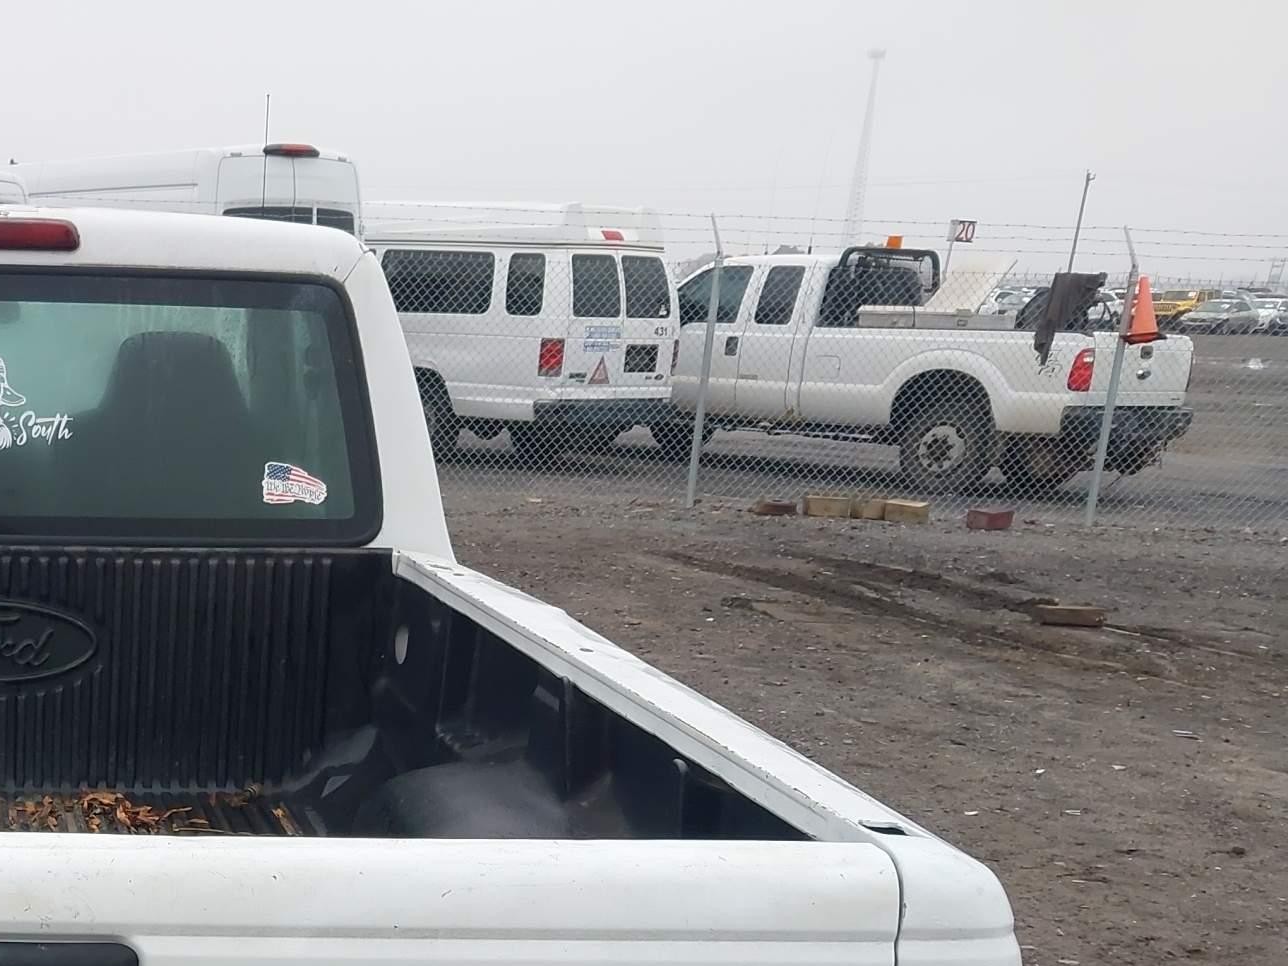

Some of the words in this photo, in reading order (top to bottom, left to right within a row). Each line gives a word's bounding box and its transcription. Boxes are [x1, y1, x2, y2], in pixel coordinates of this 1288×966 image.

[955, 222, 976, 241] 20
[654, 326, 668, 337] 431
[16, 410, 74, 446] South
